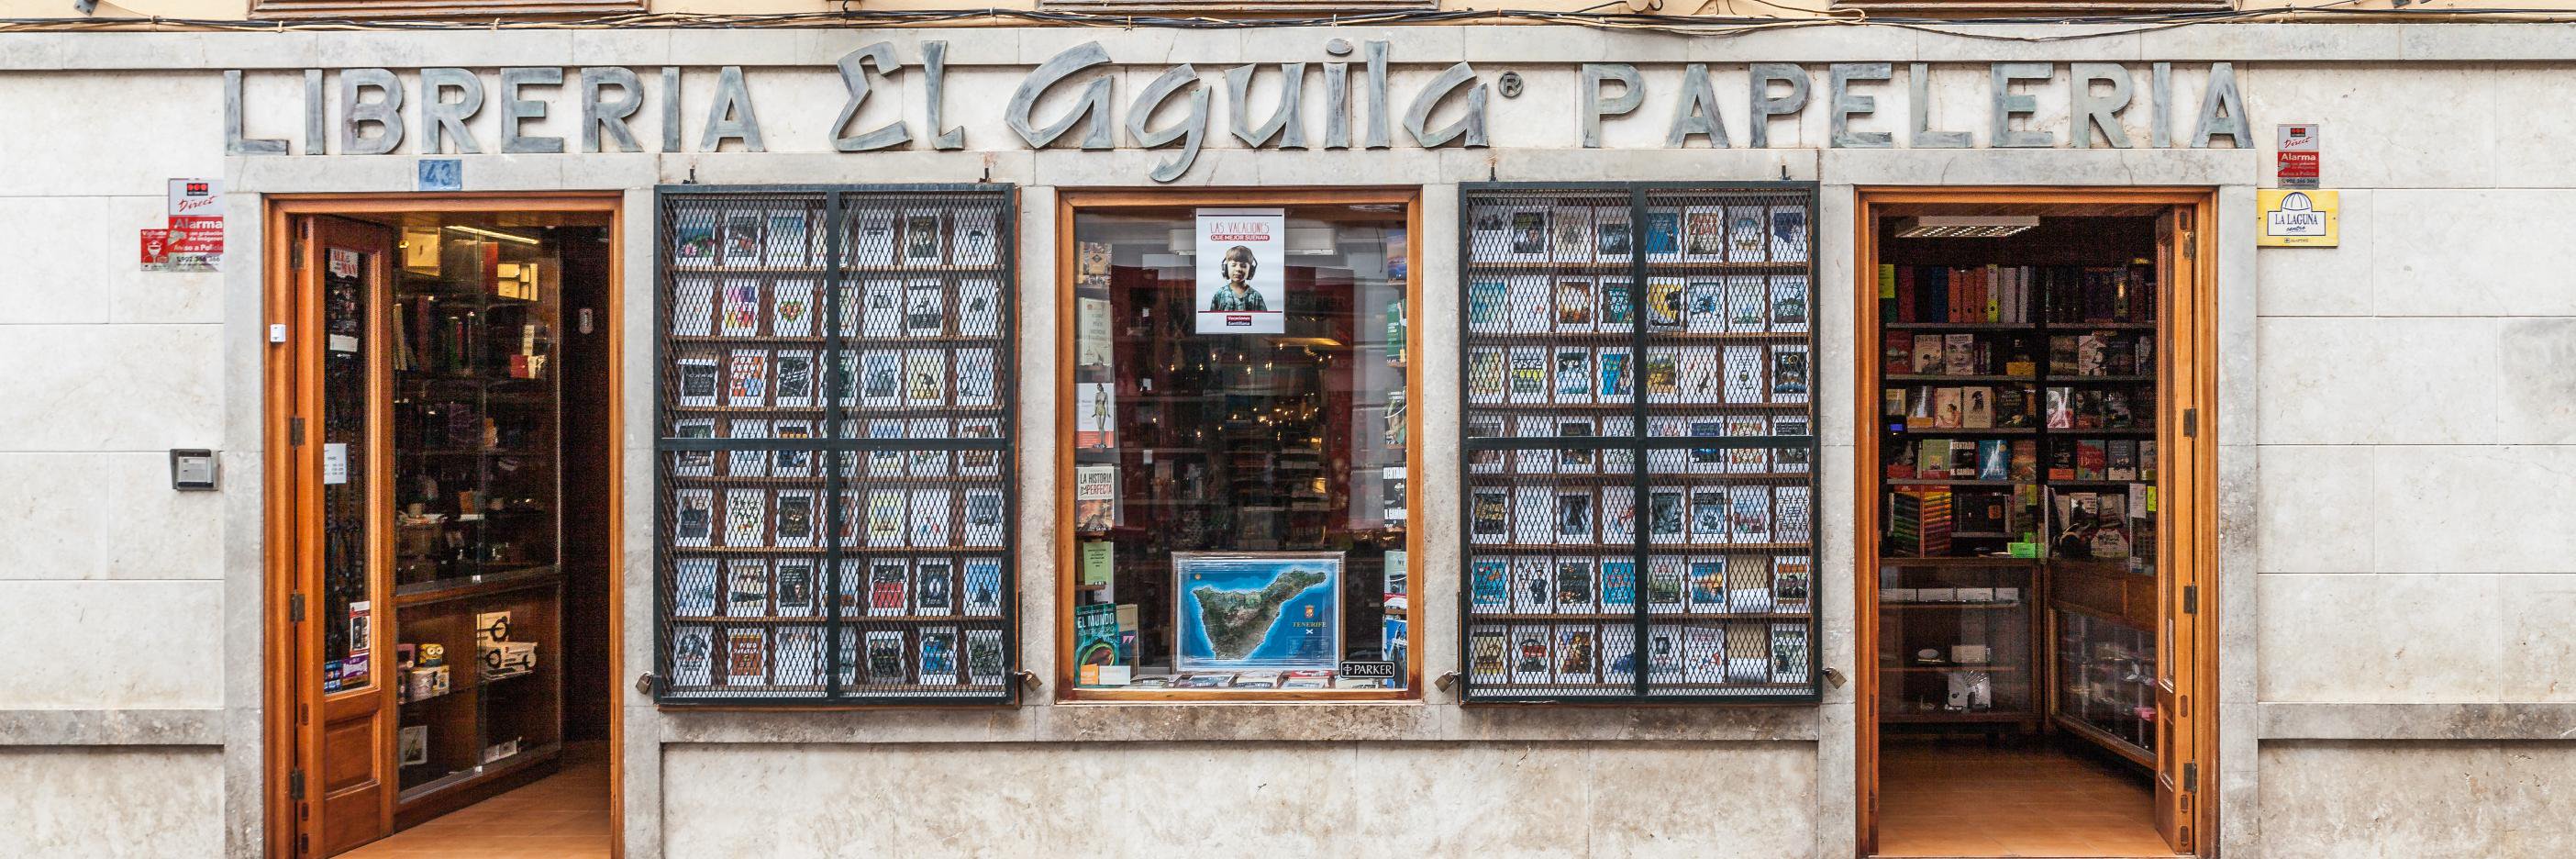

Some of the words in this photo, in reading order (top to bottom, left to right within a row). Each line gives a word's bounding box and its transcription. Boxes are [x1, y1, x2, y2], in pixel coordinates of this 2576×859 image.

[224, 66, 765, 156] LIBRERIA
[828, 40, 965, 151] El
[1582, 61, 2255, 150] PAPELERIA
[174, 218, 223, 229] Alarma
[2275, 214, 2285, 225] LA
[2287, 214, 2318, 226] LAGUNA
[1210, 221, 1224, 234] LAS
[1227, 221, 1270, 234] VACACIONES
[1080, 474, 1087, 484] LA
[1089, 473, 1113, 485] HISTORIA
[1077, 616, 1086, 629] EL
[1088, 612, 1115, 627] MUNDO
[1354, 664, 1393, 675] PARKER
